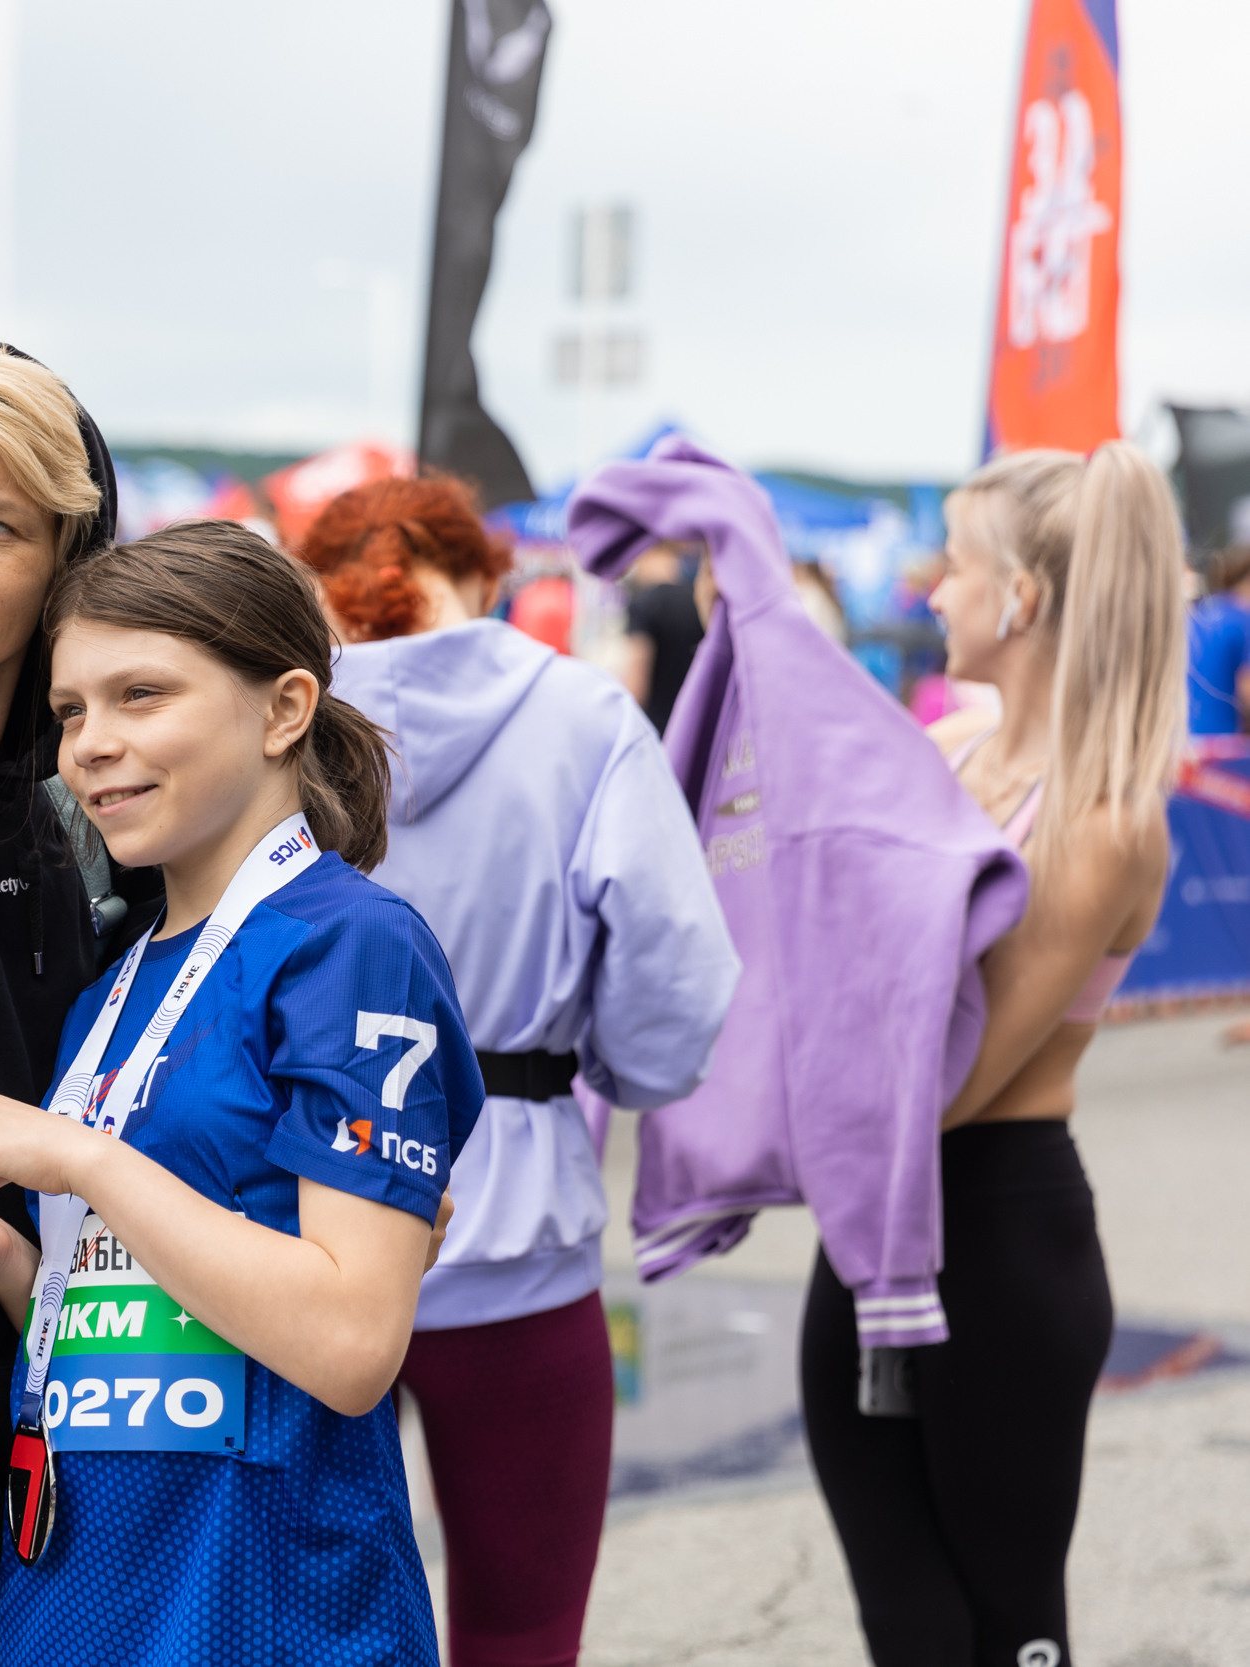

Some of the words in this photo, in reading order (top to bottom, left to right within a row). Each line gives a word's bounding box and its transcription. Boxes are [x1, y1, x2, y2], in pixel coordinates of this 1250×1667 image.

[355, 1010, 437, 1112] 7
[382, 1131, 437, 1176] ПСБ
[44, 1377, 224, 1430] 0270
